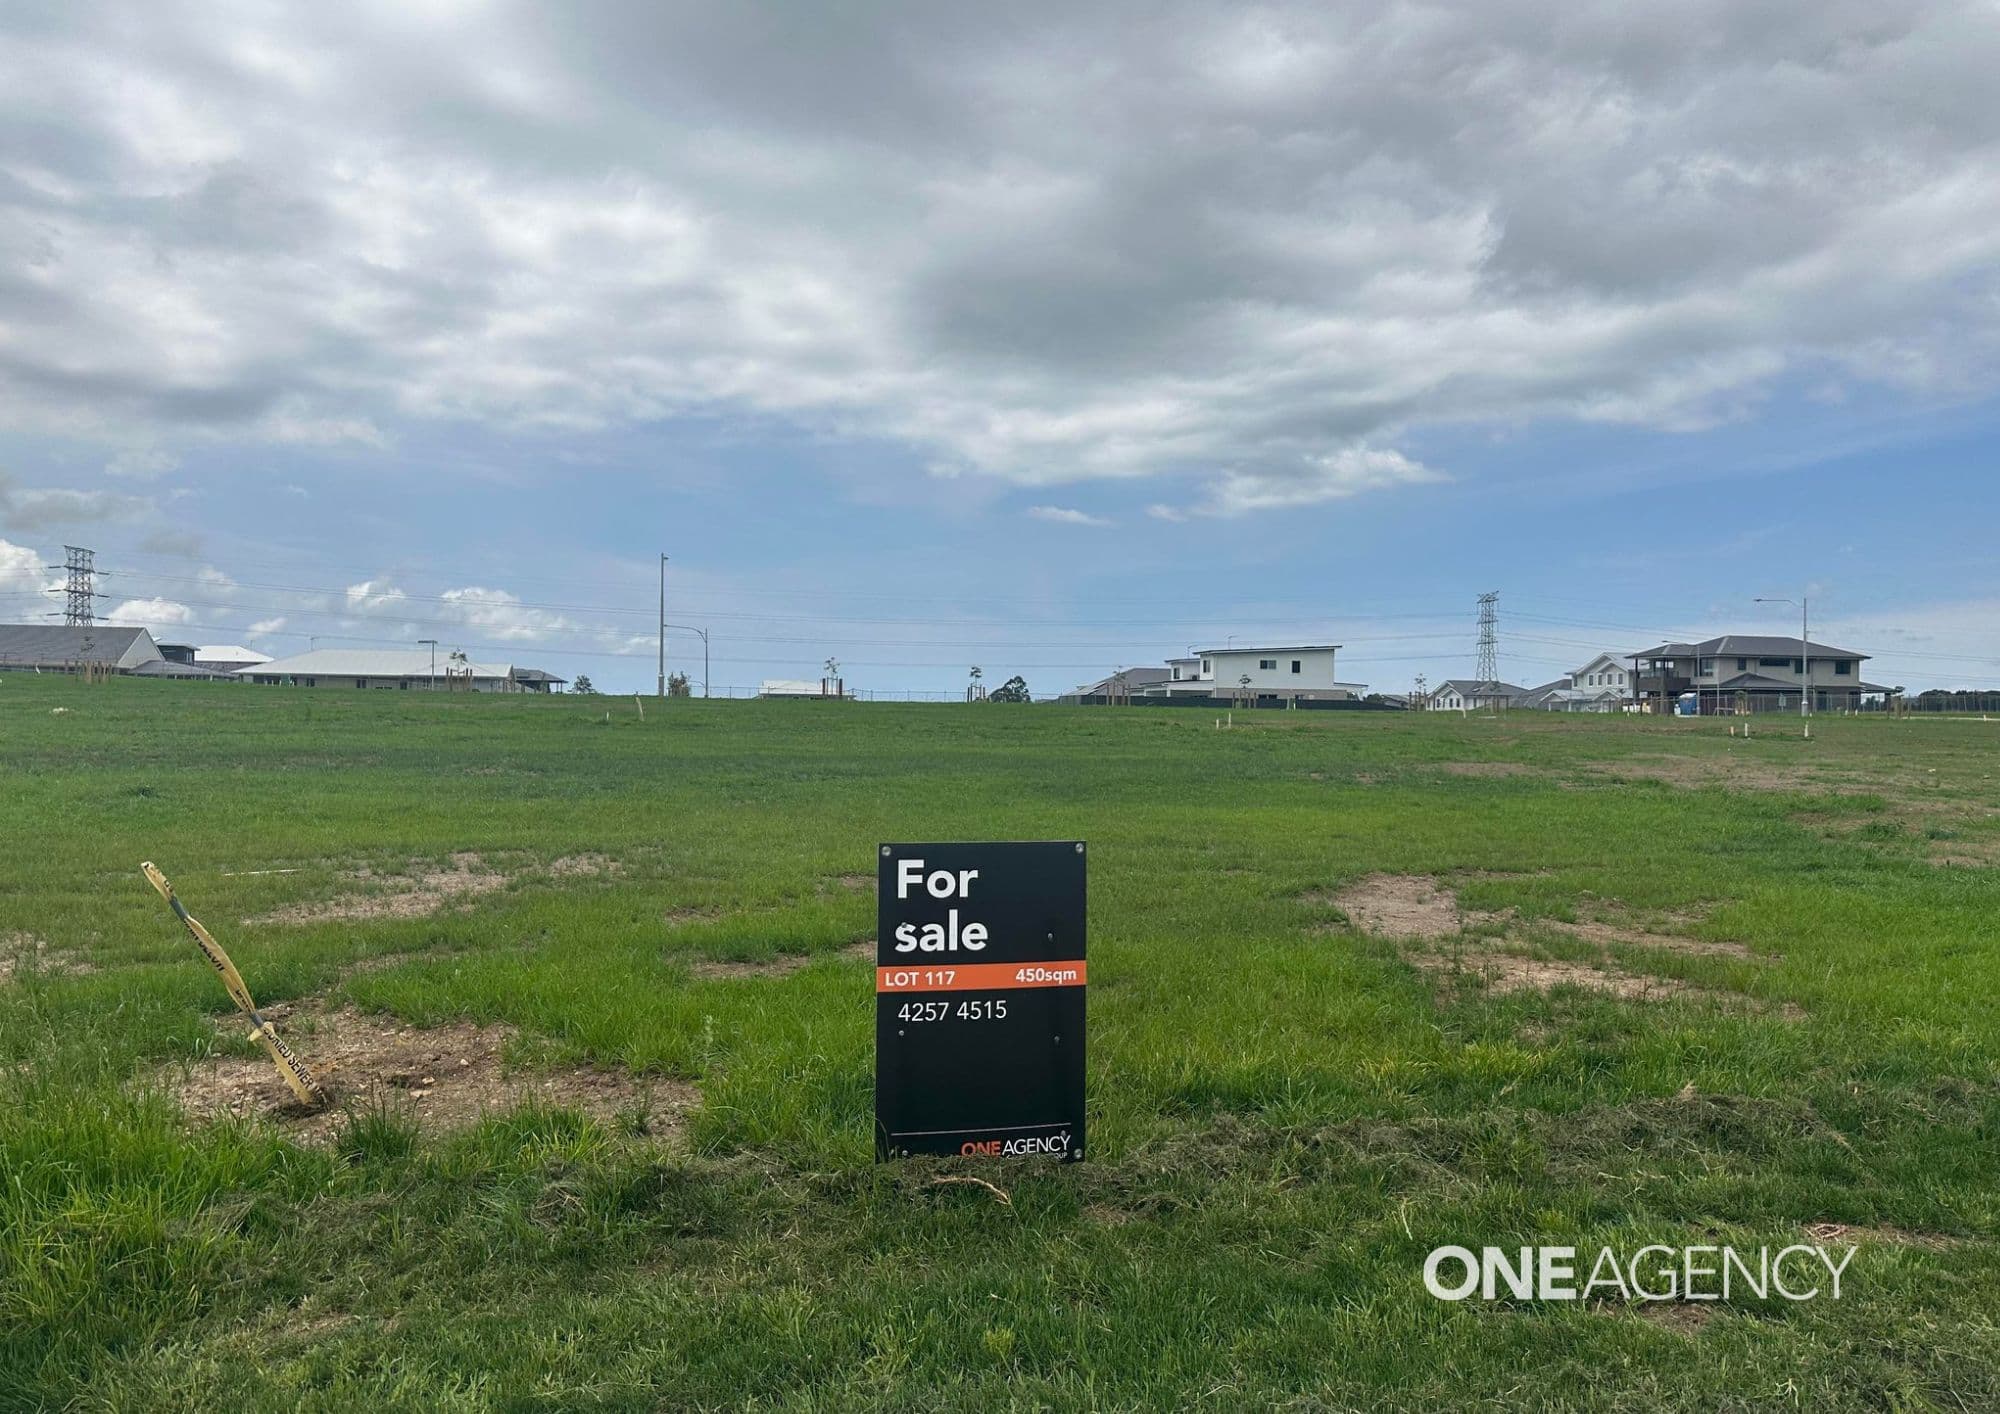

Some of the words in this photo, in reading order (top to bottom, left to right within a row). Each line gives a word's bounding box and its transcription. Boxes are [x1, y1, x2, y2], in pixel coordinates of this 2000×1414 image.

[898, 859, 978, 899] For
[895, 909, 988, 952] sale
[885, 972, 919, 986] LOT
[925, 971, 956, 985] 117
[1015, 967, 1077, 984] 450sqm
[898, 1002, 949, 1022] 4257
[956, 1000, 1007, 1020] 4515
[287, 1056, 314, 1089] SEWER
